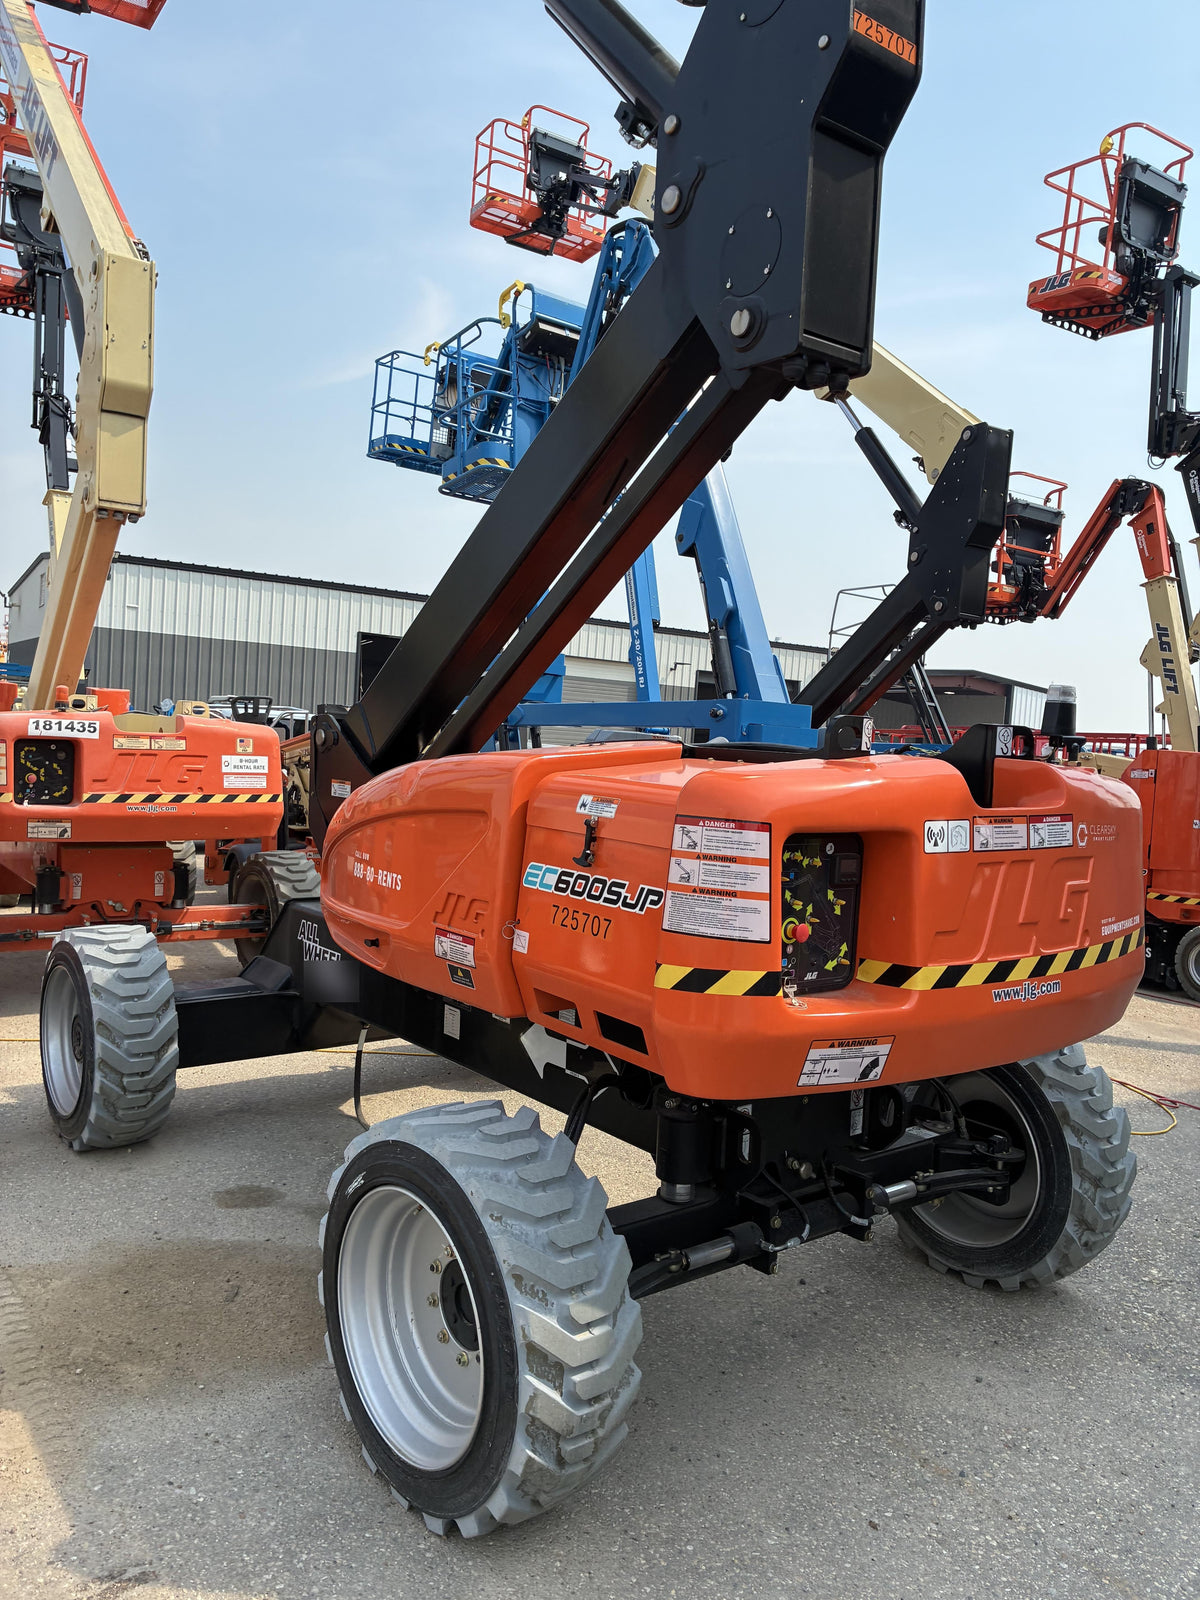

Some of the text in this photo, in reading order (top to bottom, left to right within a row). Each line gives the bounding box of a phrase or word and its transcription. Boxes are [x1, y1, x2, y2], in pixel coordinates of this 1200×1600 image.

[854, 10, 915, 61] 725707
[34, 110, 59, 181] LIFT
[1038, 271, 1073, 295] JLG
[633, 629, 645, 675] Z-30/20N
[1156, 622, 1180, 695] JLG LIFT
[32, 720, 97, 733] 181435
[92, 752, 208, 793] JLG
[127, 804, 177, 813] www.jlg.com
[704, 820, 736, 829] DANGER
[1090, 824, 1117, 835] CLEARSKY
[702, 854, 737, 863] WARNING
[353, 861, 402, 891] 888-80-RENTS
[523, 862, 664, 915] EC600SJP
[699, 887, 737, 898] WARNING
[432, 892, 489, 936] JLG
[551, 904, 612, 939] 725707
[925, 856, 1095, 966] JLG
[297, 919, 320, 945] ALL
[803, 971, 818, 980] JLG
[992, 980, 1061, 1002] www.jlg.com
[837, 1039, 878, 1048] WARNING
